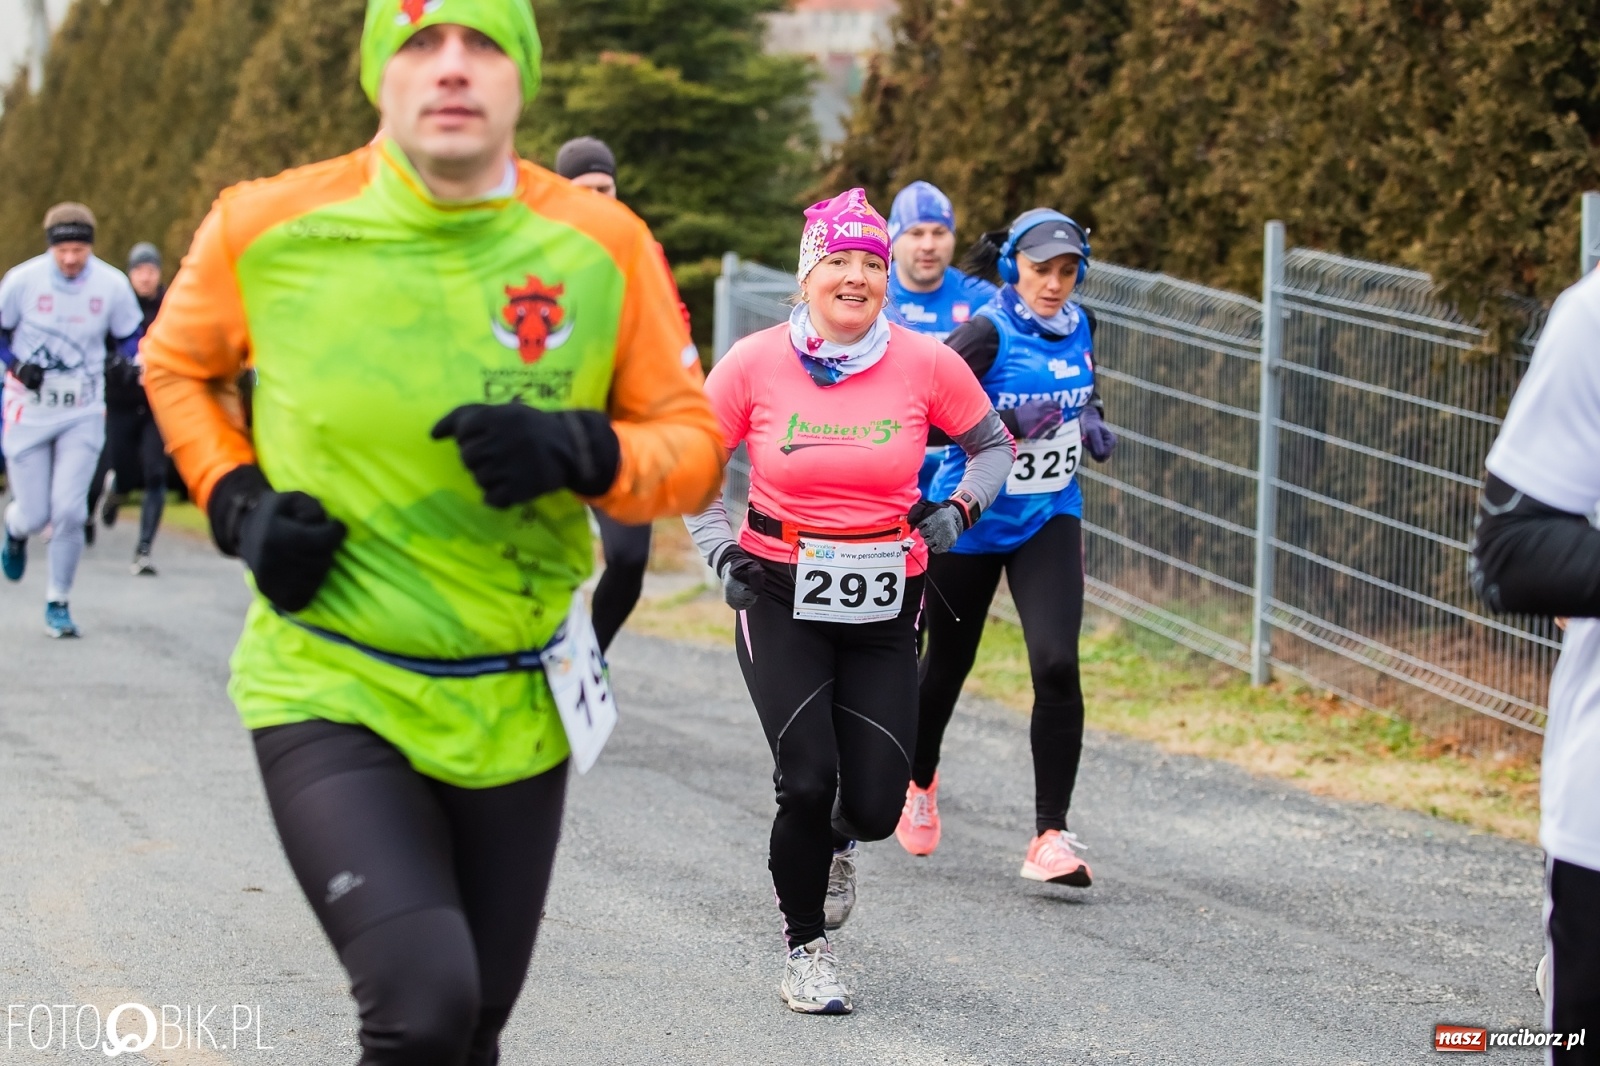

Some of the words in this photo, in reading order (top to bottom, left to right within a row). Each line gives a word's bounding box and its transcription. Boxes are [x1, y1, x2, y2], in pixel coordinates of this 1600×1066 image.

[833, 221, 862, 240] XIII
[797, 421, 871, 439] Kobiety
[1014, 445, 1077, 481] 325
[840, 550, 902, 561] www.personalbest.pl
[802, 569, 898, 608] 293
